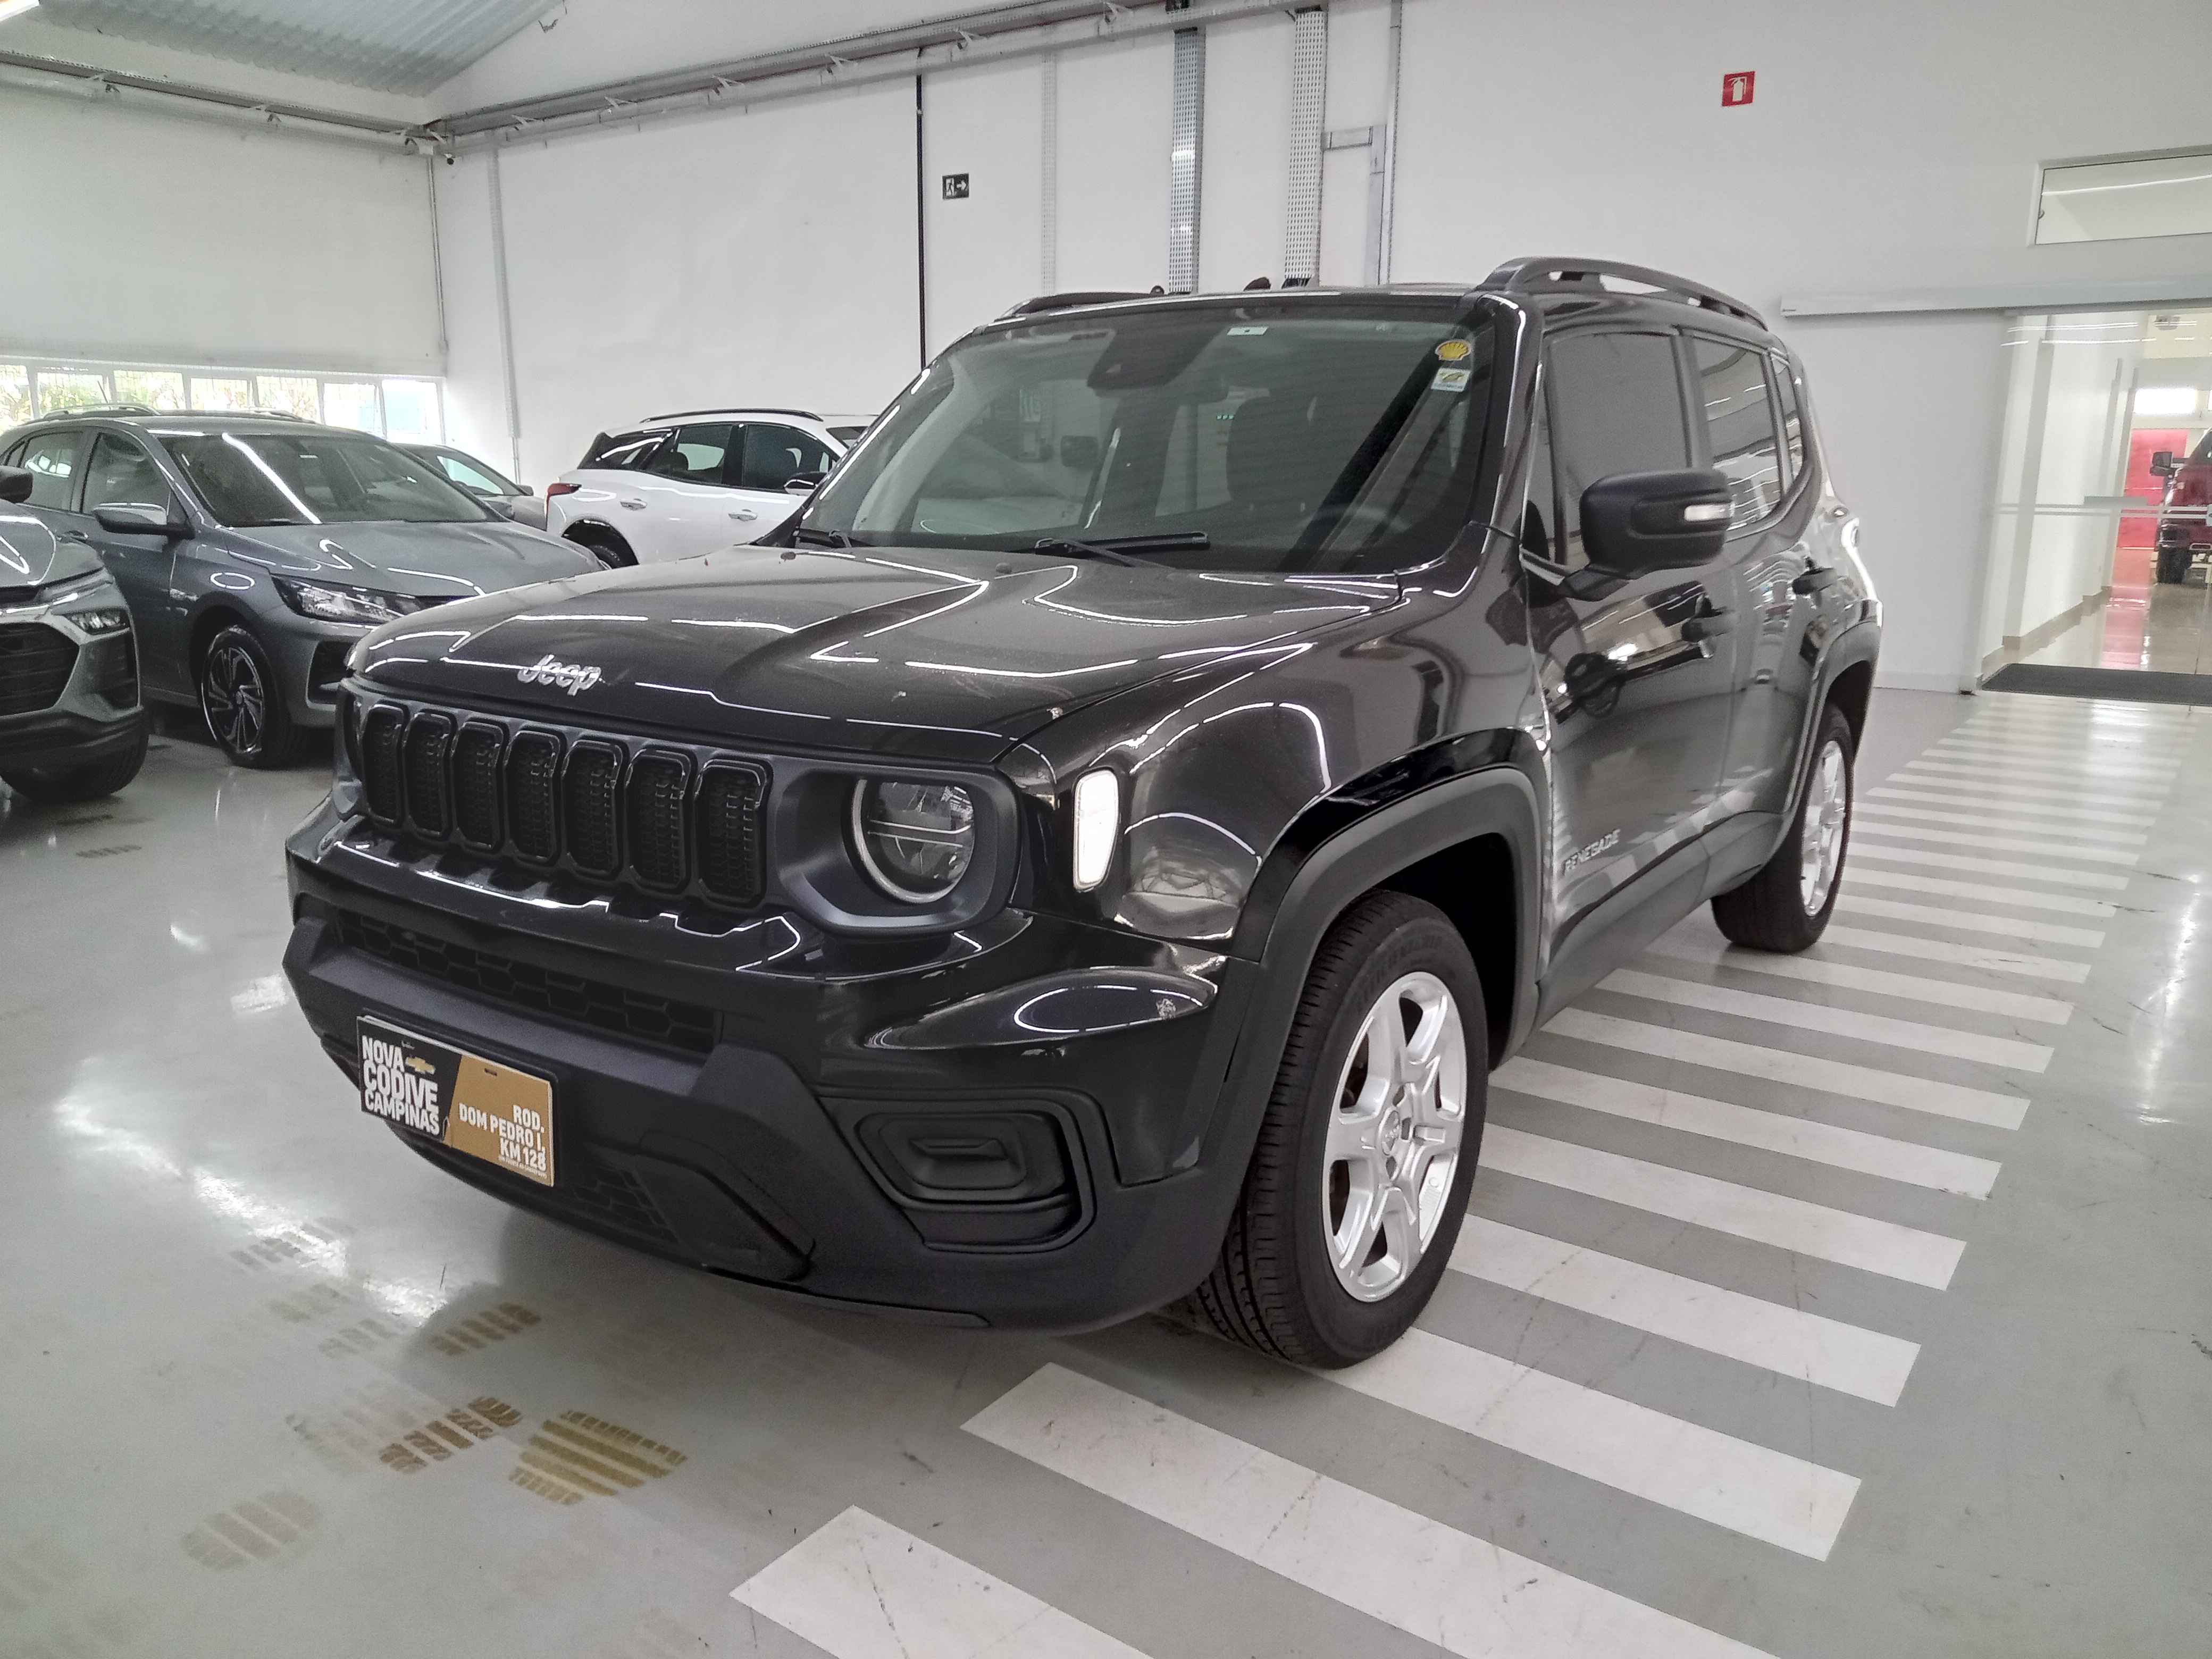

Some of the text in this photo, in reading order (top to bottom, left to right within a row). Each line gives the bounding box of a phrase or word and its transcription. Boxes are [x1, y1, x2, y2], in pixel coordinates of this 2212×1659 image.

[517, 654, 601, 696] Jeep
[362, 1035, 405, 1073] NOVA
[364, 1059, 439, 1115] CODIVE
[365, 1089, 440, 1135] CAMPINAS
[458, 1102, 488, 1130] DOM
[490, 1114, 534, 1148] PEDRO
[513, 1104, 545, 1133] ROD.
[500, 1137, 521, 1162] KM
[523, 1146, 547, 1172] 128
